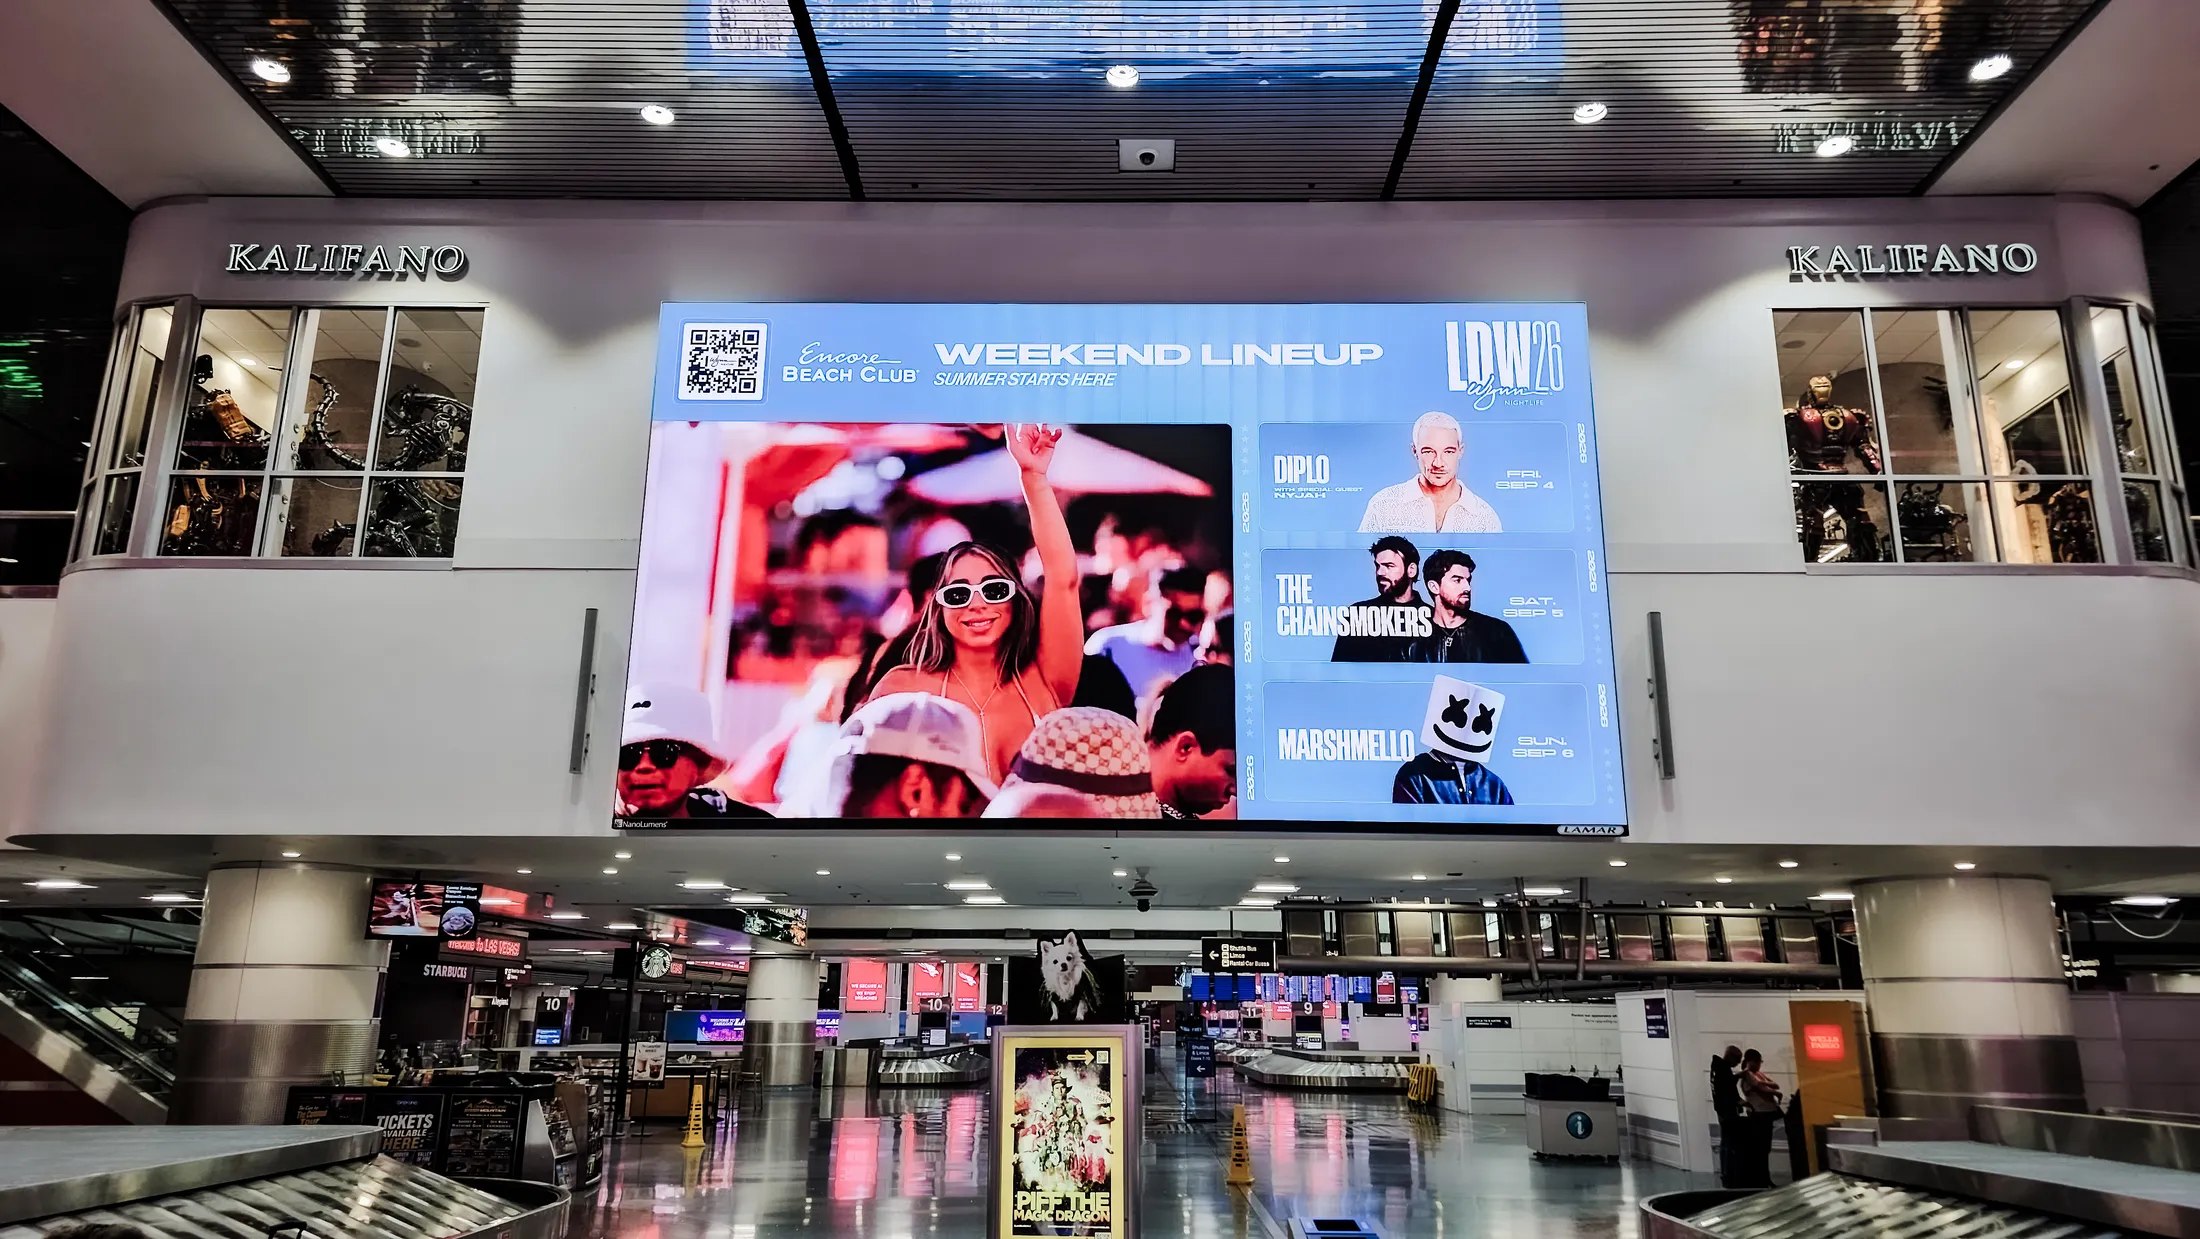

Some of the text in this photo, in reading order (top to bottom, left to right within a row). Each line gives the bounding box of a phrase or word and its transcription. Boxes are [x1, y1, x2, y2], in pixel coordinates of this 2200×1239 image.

[226, 244, 466, 273] KALIFANO
[1787, 243, 2038, 273] KALIFANO
[799, 341, 902, 365] Encore
[933, 343, 1384, 366] WEEKEND LINEUP
[1445, 320, 1565, 392] LDW26
[782, 366, 917, 382] BEACH CLUB
[933, 372, 1117, 387] SUMMER STARTS HERE
[1467, 373, 1553, 411] Wynn
[1274, 454, 1330, 484] DIPLO
[1506, 470, 1541, 478] FRI.
[1495, 481, 1555, 489] SEP 4
[1276, 574, 1314, 604] THE
[1509, 597, 1556, 606] SAT.
[1503, 609, 1564, 617] SEP 5
[1276, 605, 1433, 637] CHAINSMOKERS
[1278, 728, 1416, 762] MARSHMELLO
[1517, 736, 1568, 746] SUN.
[1512, 749, 1574, 758] SEP 6
[622, 821, 668, 829] NanoLumens
[1563, 824, 1617, 834] LAMAR
[423, 964, 467, 979] STARBUCKS
[545, 997, 561, 1011] 10
[927, 998, 943, 1011] 10
[991, 1005, 1003, 1015] 12
[1303, 1001, 1314, 1015] 9
[1246, 1007, 1257, 1017] 11
[376, 1114, 434, 1130] TICKETS
[382, 1128, 428, 1138] AVAILABLE
[1016, 1190, 1110, 1212] PIFF THE
[1013, 1209, 1110, 1222] MAGIC DRAGON
